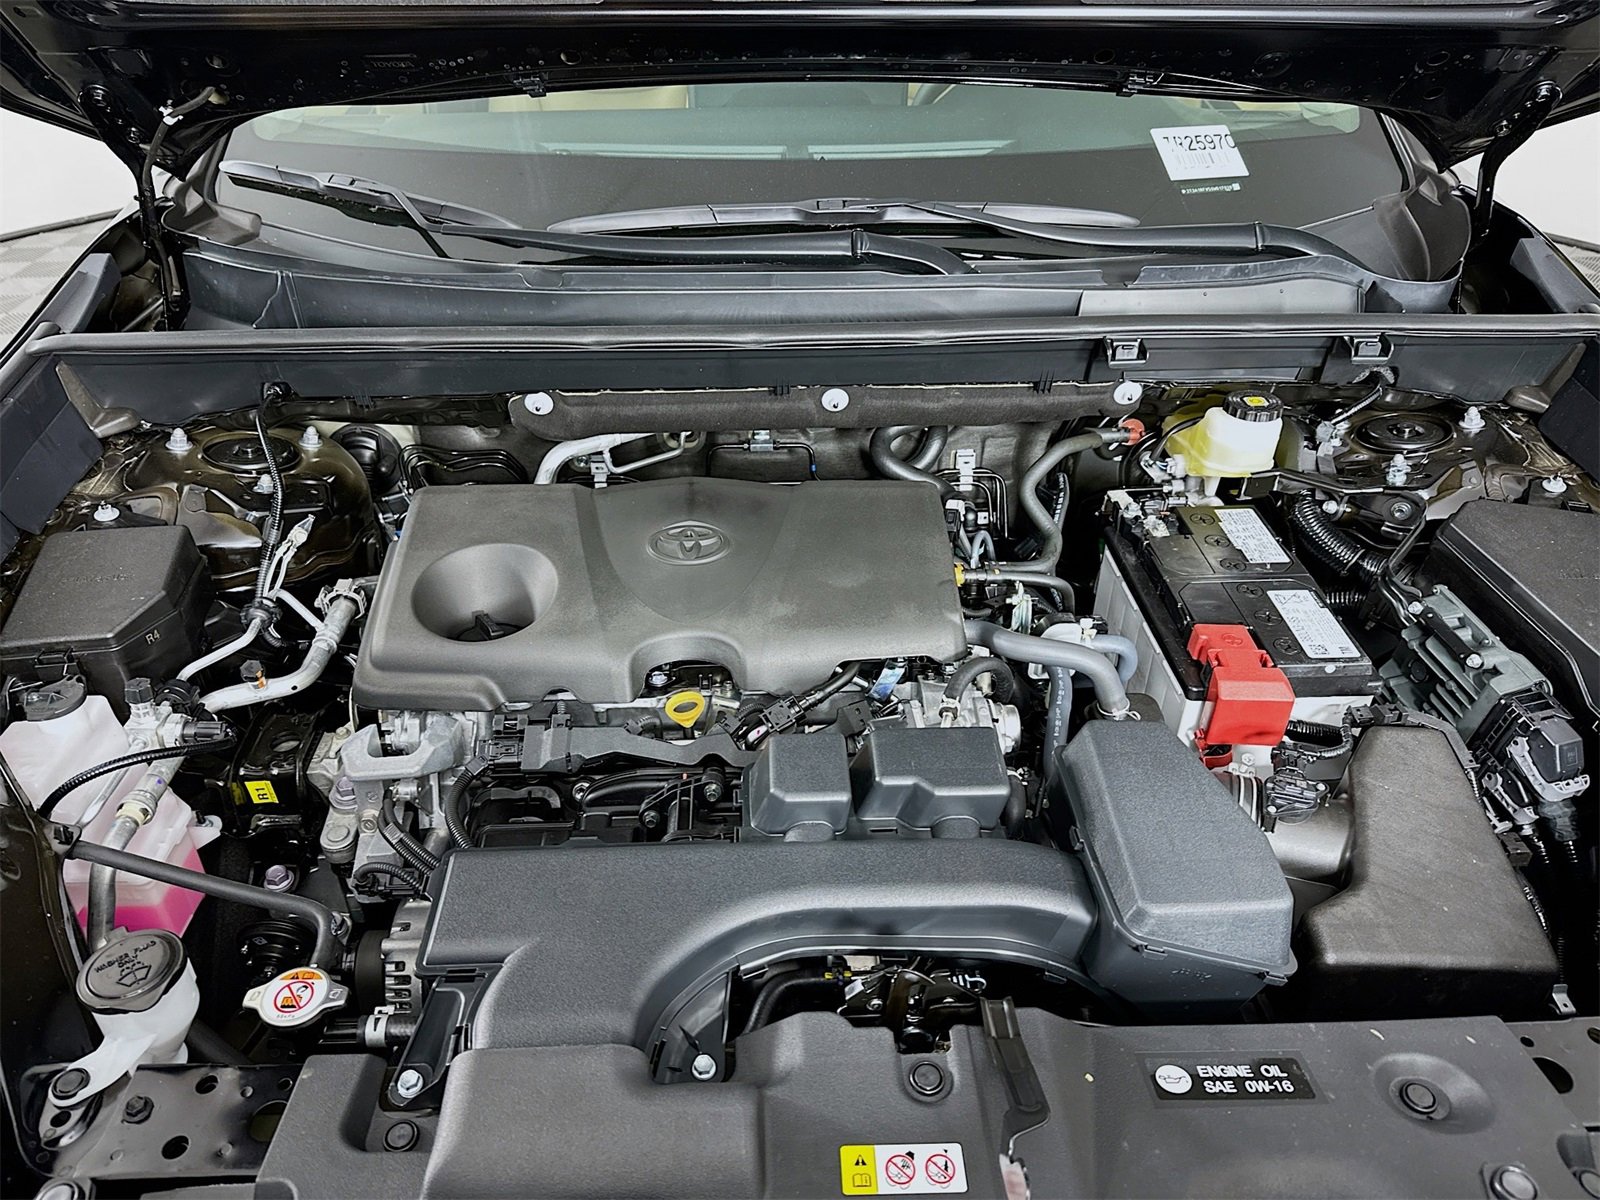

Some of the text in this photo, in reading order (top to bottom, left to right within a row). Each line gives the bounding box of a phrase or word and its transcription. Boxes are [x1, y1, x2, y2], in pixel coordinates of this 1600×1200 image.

[370, 60, 415, 69] TOYOTA
[144, 629, 161, 645] R4
[255, 787, 270, 801] R1
[1196, 1064, 1289, 1078] ENGINE OIL
[1203, 1080, 1295, 1093] SAE 0W-16
